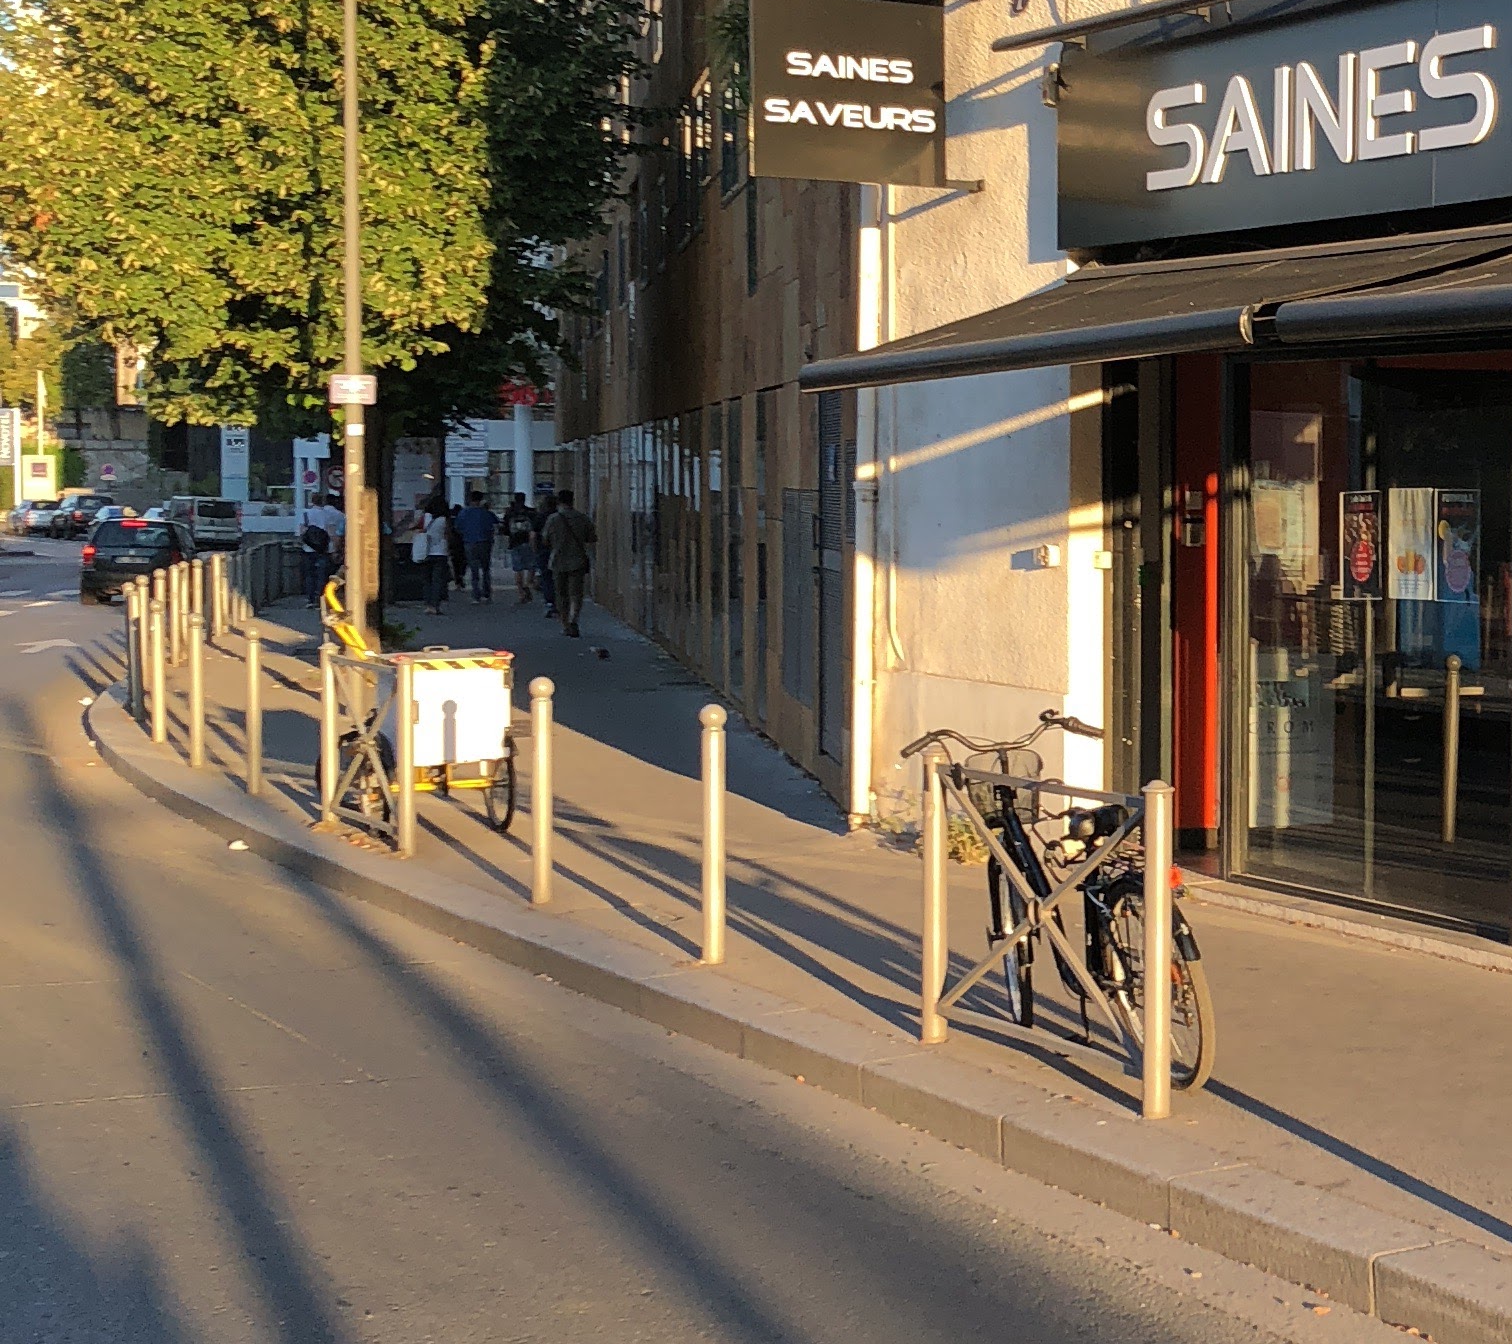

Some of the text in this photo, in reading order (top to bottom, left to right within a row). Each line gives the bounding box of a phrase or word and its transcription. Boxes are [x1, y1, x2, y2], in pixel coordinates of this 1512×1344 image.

[785, 51, 914, 84] SAINES
[764, 99, 937, 133] SAVEURS
[1146, 25, 1498, 192] SAINES
[0, 414, 10, 458] NOVOTEL
